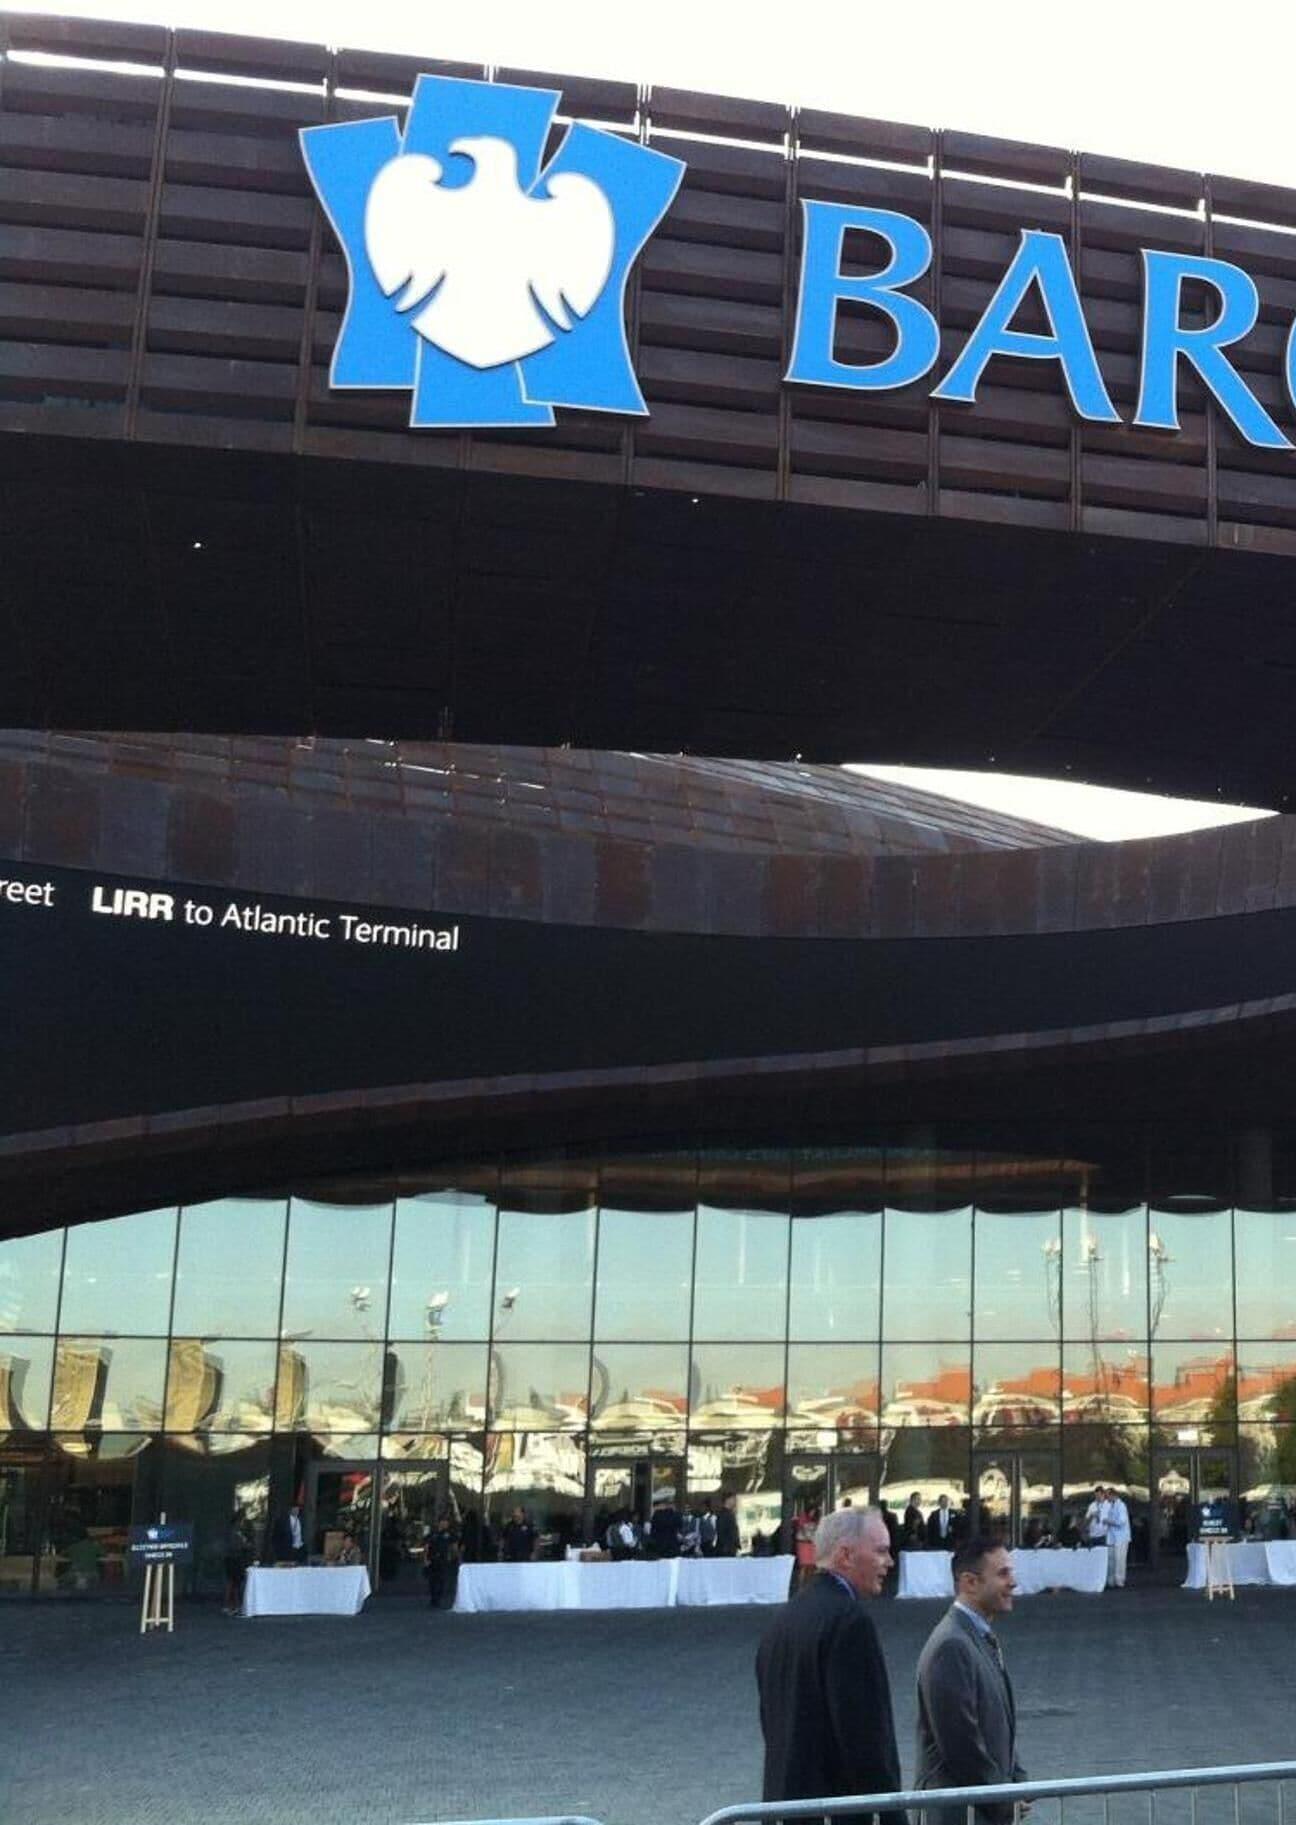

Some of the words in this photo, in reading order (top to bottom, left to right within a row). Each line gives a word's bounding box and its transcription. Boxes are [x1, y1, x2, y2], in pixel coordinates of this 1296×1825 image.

[92, 885, 175, 921] LIRR
[183, 899, 214, 926] to
[220, 903, 331, 939] Atlantic
[339, 914, 460, 950] Terminal
